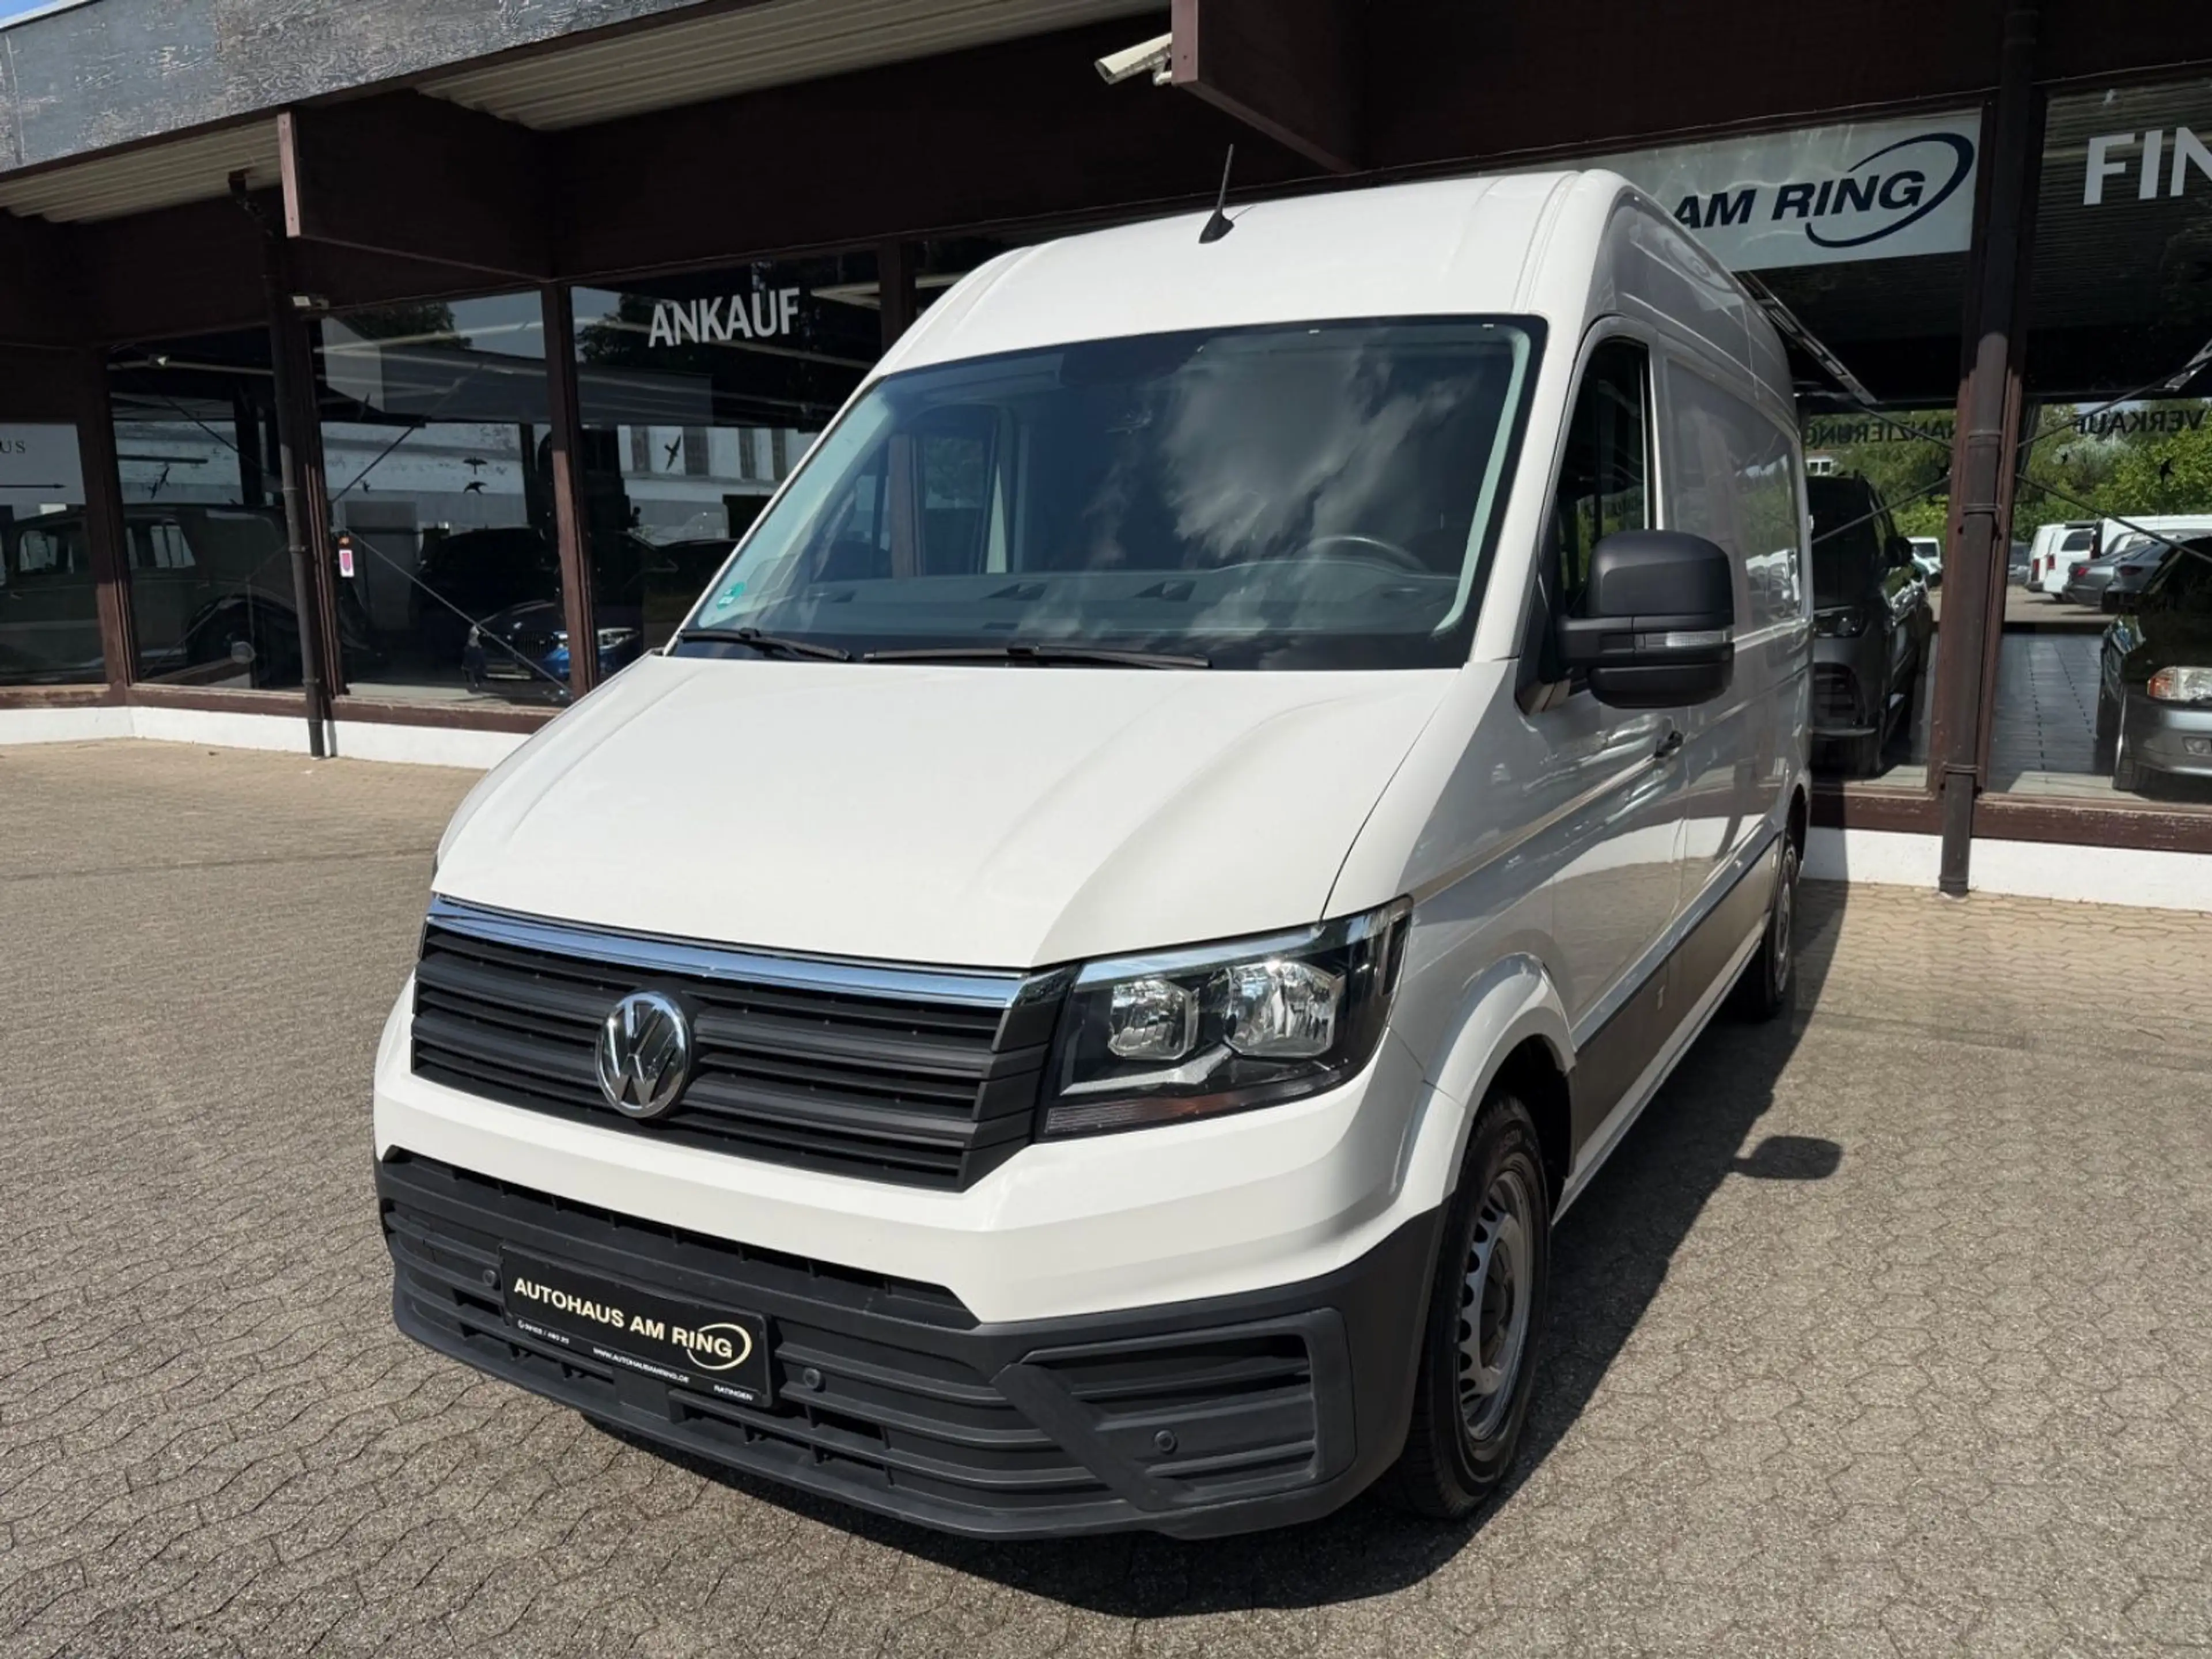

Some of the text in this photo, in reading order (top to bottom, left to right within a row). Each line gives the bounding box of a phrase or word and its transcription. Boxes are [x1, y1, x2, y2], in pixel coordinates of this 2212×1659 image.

[1672, 171, 1926, 229] AM RING
[2083, 126, 2212, 206] FIN
[648, 287, 800, 349] ANKAUF
[514, 1277, 733, 1359] AUTOHAUS AM RING
